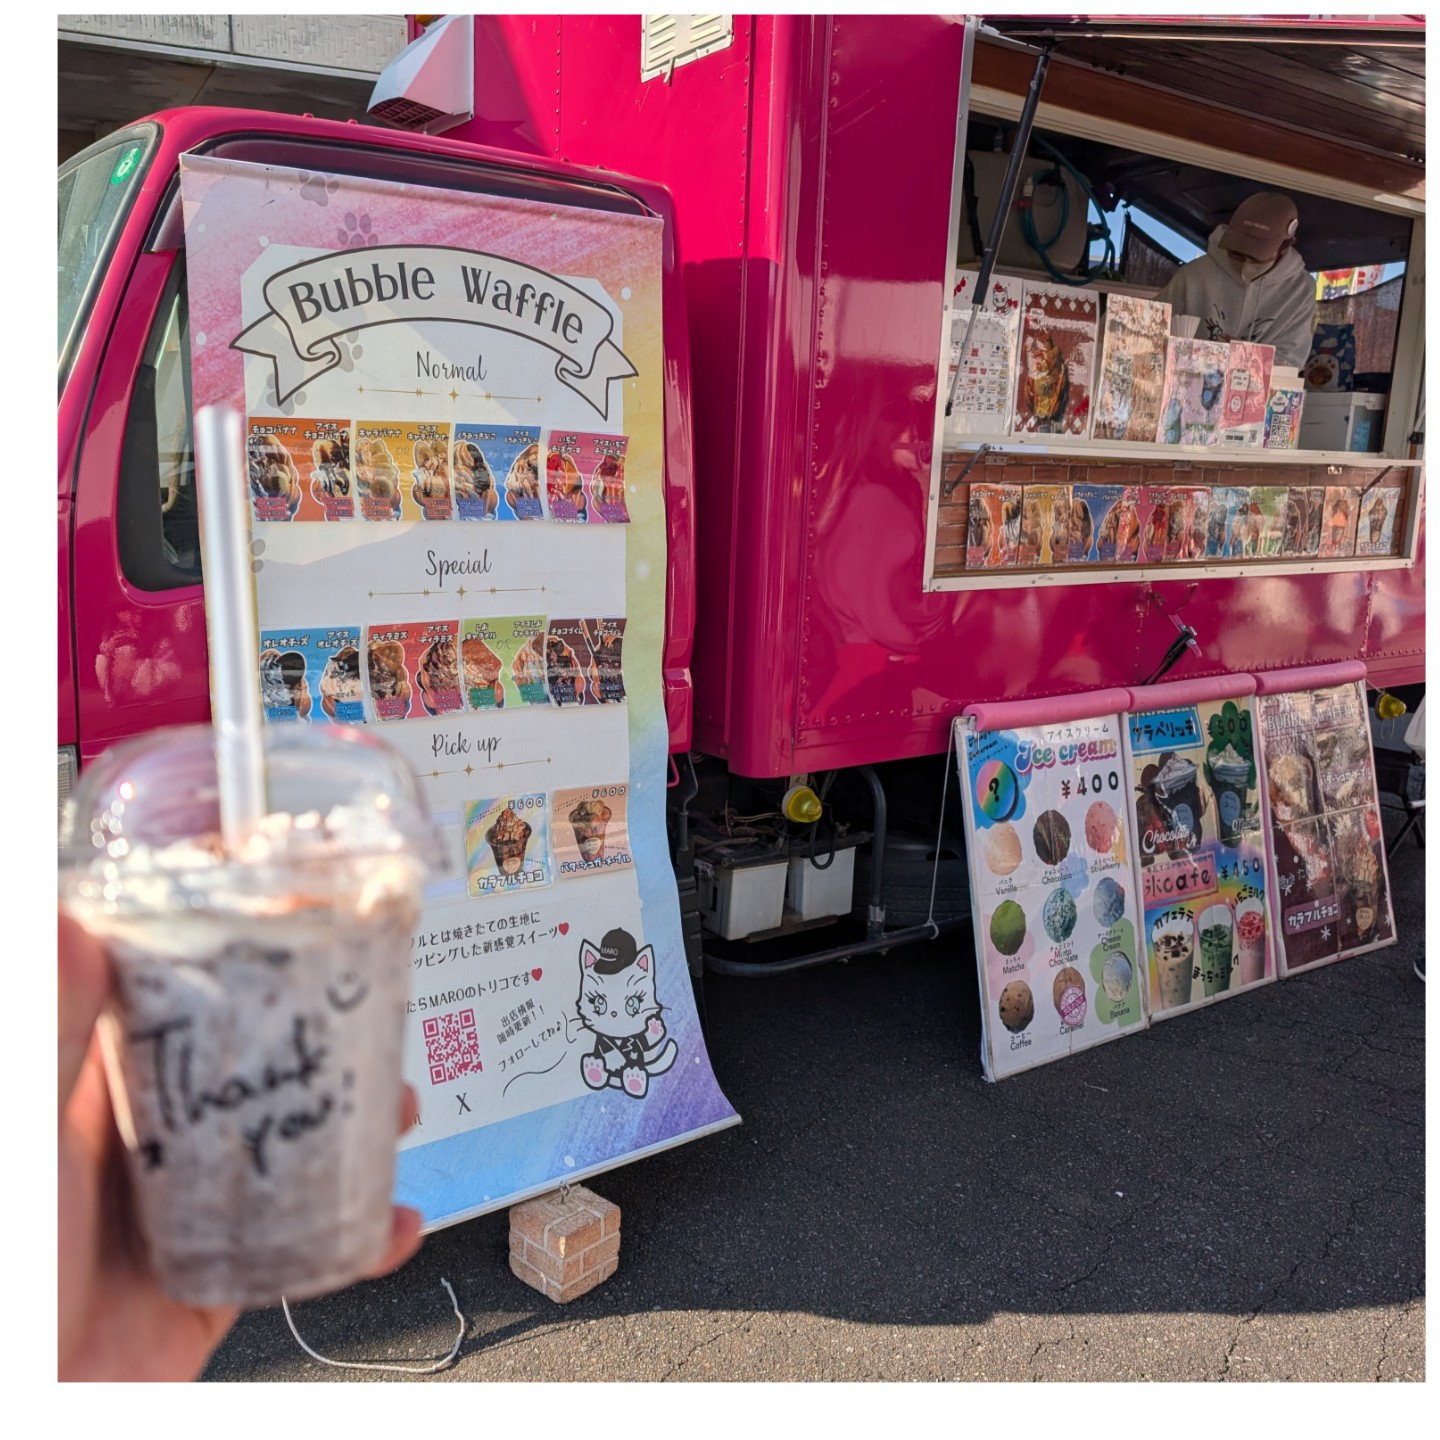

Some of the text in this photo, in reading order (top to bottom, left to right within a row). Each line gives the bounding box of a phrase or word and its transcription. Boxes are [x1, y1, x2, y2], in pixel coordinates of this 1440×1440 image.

[287, 262, 584, 344] Bubble Waffle
[416, 350, 488, 383] Normal
[426, 548, 493, 587] Special
[1047, 724, 1109, 740] アイスクリーム
[432, 732, 502, 762] Pick up
[1015, 739, 1055, 775] Ice
[1059, 737, 1117, 766] cream
[592, 786, 626, 799] ¥600
[1061, 771, 1119, 800] ¥400
[508, 796, 544, 810] ¥600
[477, 870, 545, 889] カラフルチョコ
[1221, 857, 1261, 881] ¥450
[995, 884, 1018, 895] Vanilla
[1154, 908, 1194, 930] カフェラテ
[1288, 903, 1339, 927] カラフルチョコ
[409, 926, 558, 969] ッピングした新感覚スイーツ
[601, 946, 619, 956] MARO
[1002, 963, 1025, 975] Matcha
[501, 998, 535, 1028] 出店情報
[1110, 1007, 1130, 1020] Banana
[1010, 1039, 1032, 1051] Coffee
[130, 1014, 328, 1134] Thank
